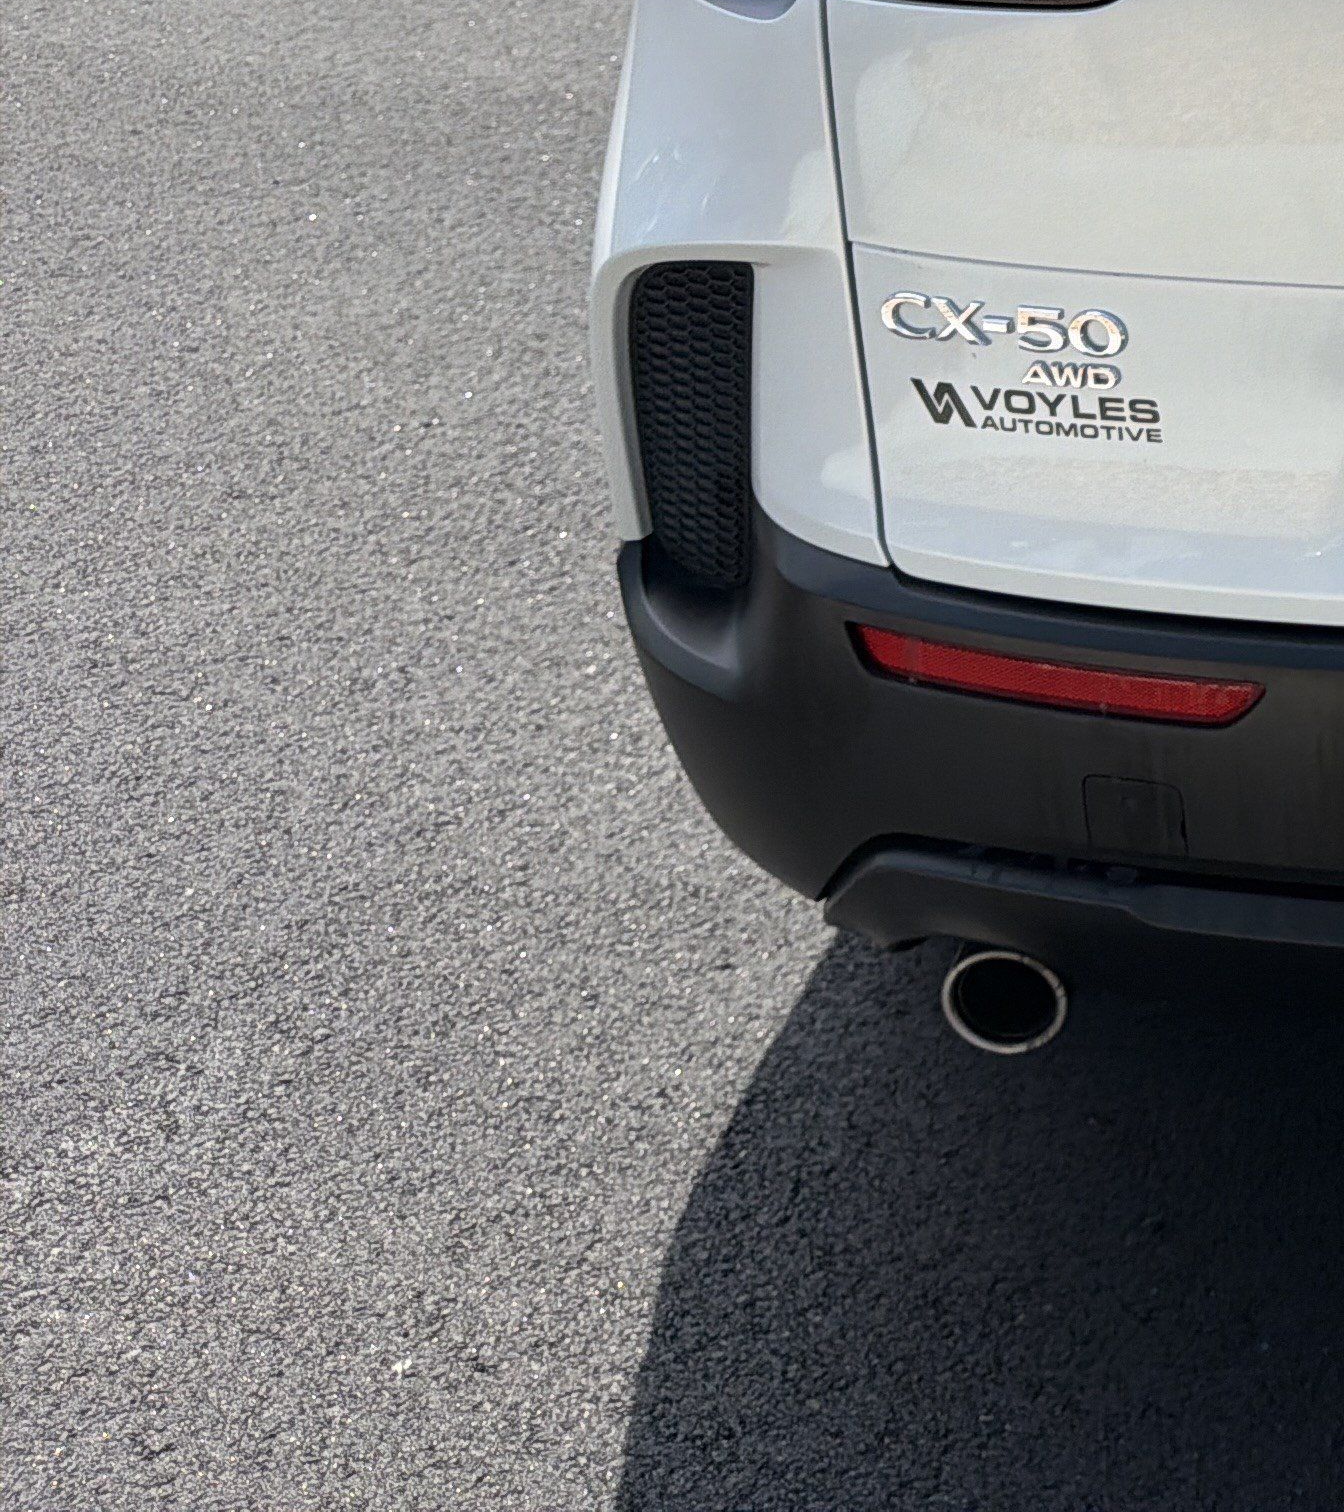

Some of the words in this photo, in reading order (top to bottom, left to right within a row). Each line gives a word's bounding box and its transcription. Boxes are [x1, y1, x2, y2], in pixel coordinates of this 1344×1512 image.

[881, 291, 1129, 357] CX-50
[1021, 360, 1121, 390] AWD
[970, 386, 1160, 423] VOYLES
[981, 416, 1163, 443] AUTOMOTIVE
